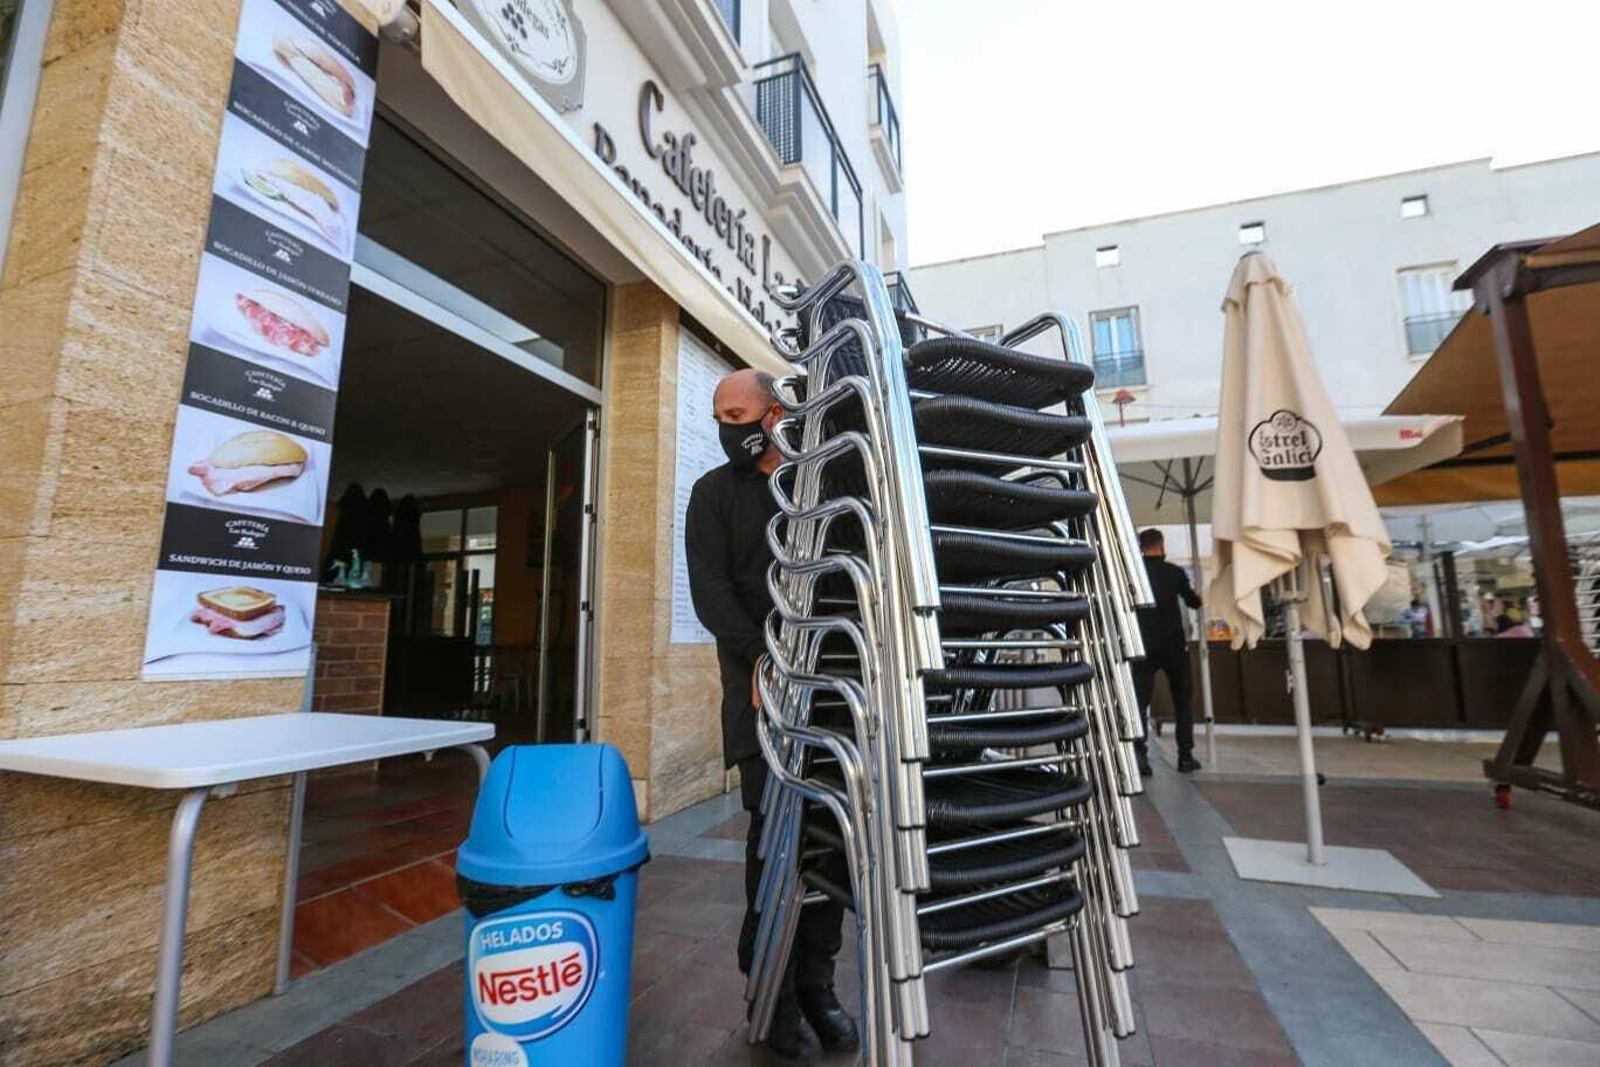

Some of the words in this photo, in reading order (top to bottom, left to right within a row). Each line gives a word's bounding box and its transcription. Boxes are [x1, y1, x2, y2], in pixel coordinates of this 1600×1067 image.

[638, 80, 756, 276] Cafetería
[213, 240, 266, 271] BOCADILLO
[265, 264, 278, 276] DE
[190, 390, 247, 413] BOCADILLO
[246, 407, 260, 418] DE
[260, 409, 291, 427] BACON
[298, 421, 326, 436] QUESO
[168, 553, 228, 568] SANDWICH
[228, 559, 242, 569] DE
[242, 559, 275, 573] JAMÓN
[274, 563, 283, 573] Y
[282, 565, 312, 576] QUESO
[480, 921, 564, 950] HELADOS
[478, 952, 583, 1006] Nestlé
